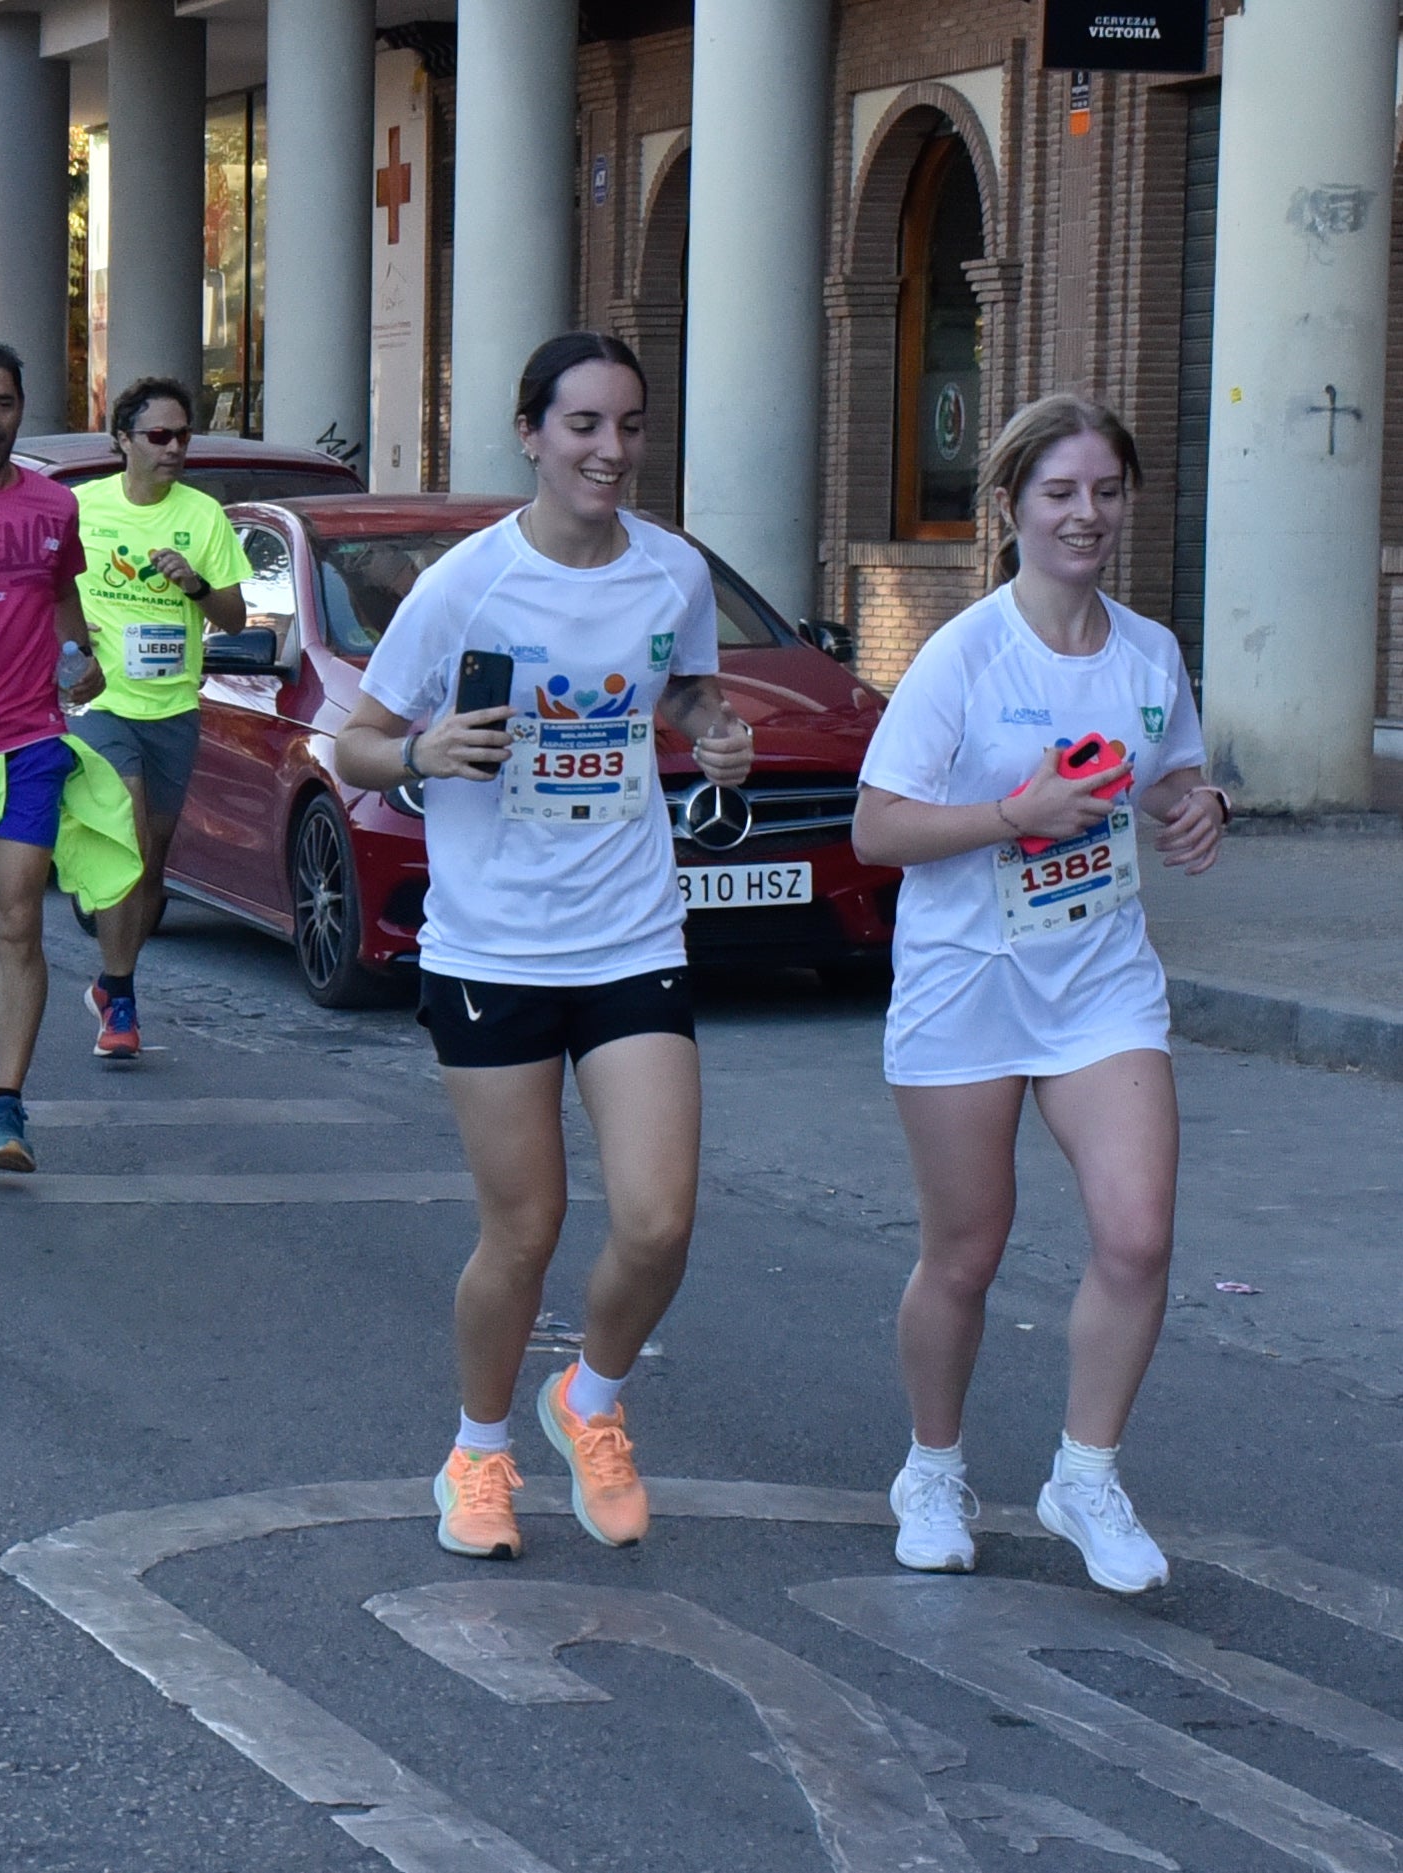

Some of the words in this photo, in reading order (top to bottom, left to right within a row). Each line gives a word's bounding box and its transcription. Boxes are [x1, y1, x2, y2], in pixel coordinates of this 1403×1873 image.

[1094, 15, 1157, 27] CERVEZAS
[1088, 26, 1161, 39] VICTORIA
[88, 588, 184, 608] CARRERA-MARCHA
[138, 643, 185, 654] LIEBRE
[532, 750, 625, 779] 1383
[1020, 844, 1113, 893] 1382
[746, 868, 803, 901] HSZ
